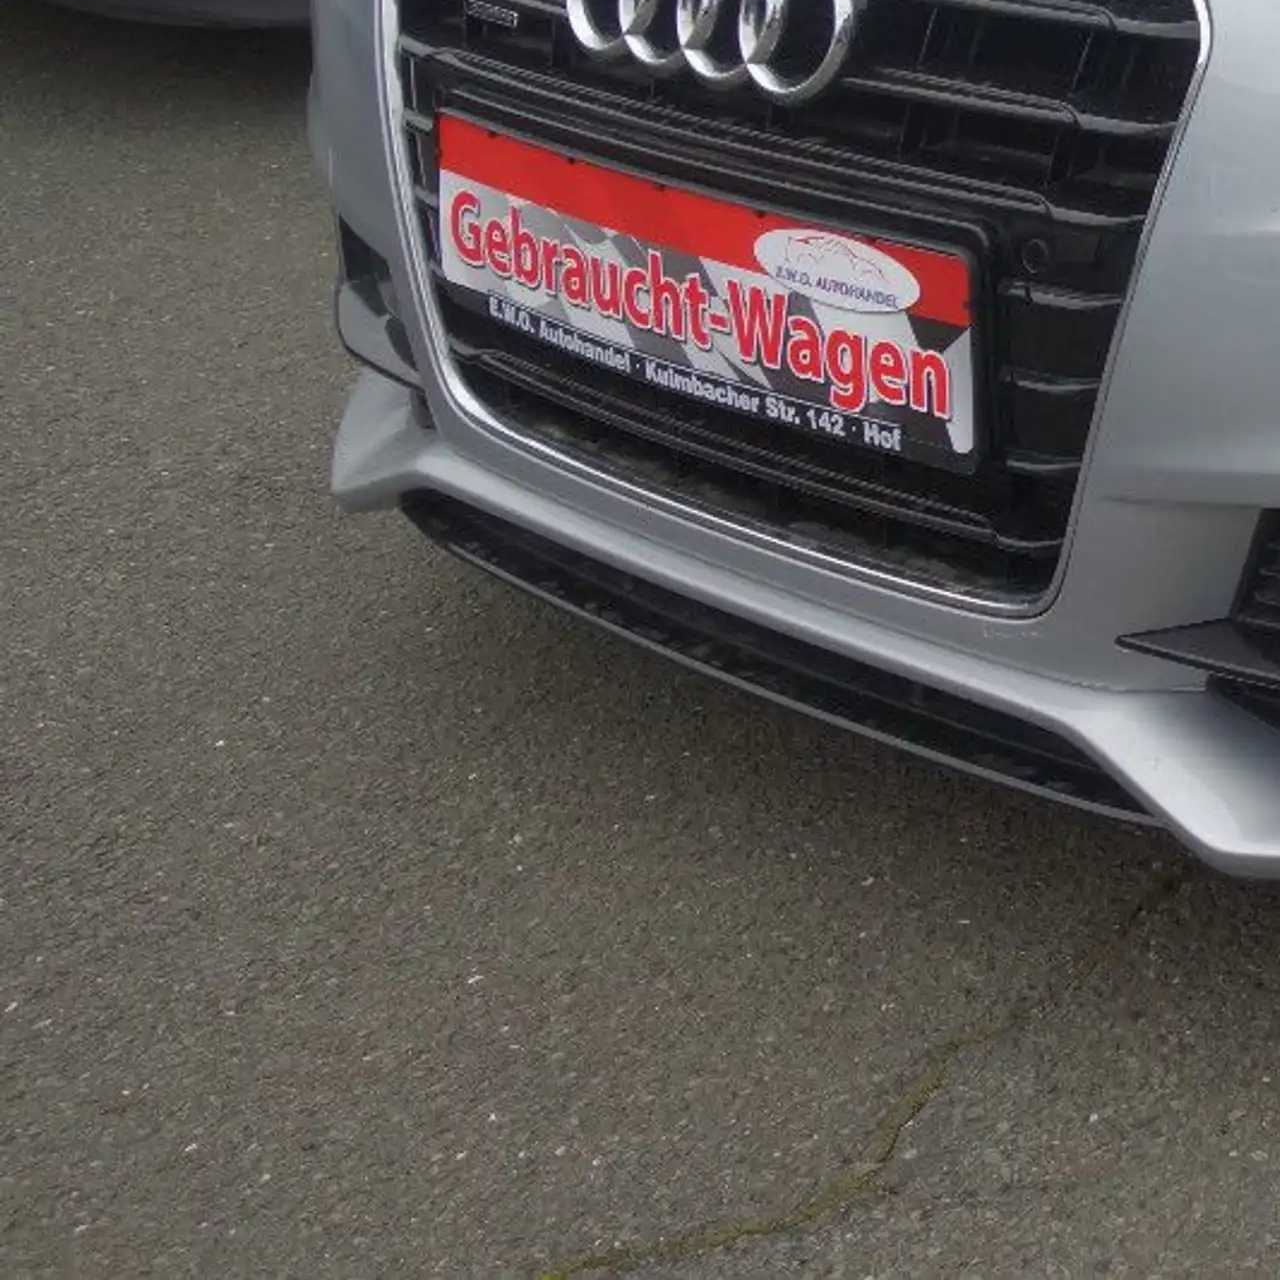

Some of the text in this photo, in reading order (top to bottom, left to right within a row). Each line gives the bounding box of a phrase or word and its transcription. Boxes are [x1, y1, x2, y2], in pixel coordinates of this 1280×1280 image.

[447, 188, 953, 420] Gebraucht-Wagen
[816, 276, 899, 310] AUTOHANDEL
[539, 320, 632, 375] Autohandel
[645, 360, 760, 413] Kulmbacher
[765, 396, 800, 425] Str.
[806, 408, 846, 437] 142
[863, 420, 902, 451] Hof
